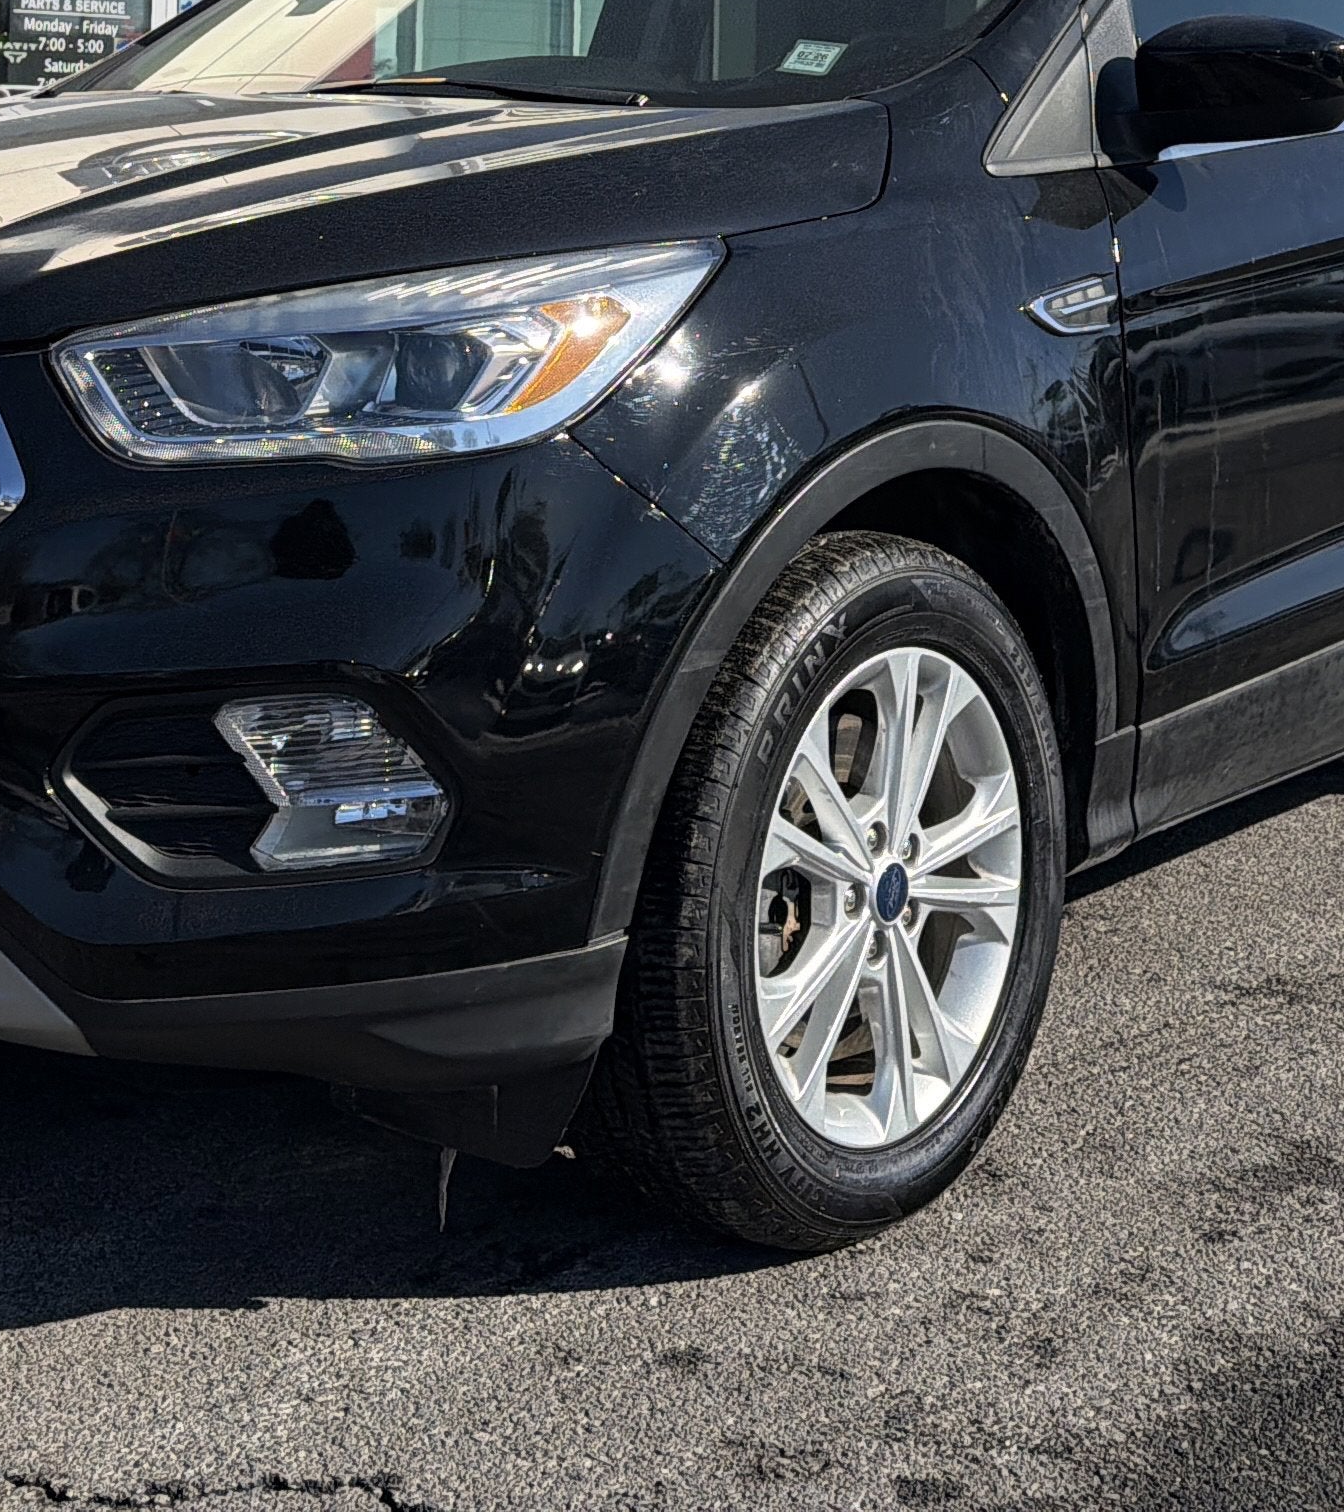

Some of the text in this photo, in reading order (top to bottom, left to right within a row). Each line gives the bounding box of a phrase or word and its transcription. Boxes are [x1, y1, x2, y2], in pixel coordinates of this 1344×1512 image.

[63, 0, 72, 12] &
[75, 0, 126, 14] SERVICE
[24, 17, 73, 36] Monday
[82, 19, 119, 39] Friday
[38, 37, 66, 52] 7:00
[77, 38, 104, 54] 5:00
[44, 57, 90, 74] Saturd
[756, 611, 849, 765] PRINX
